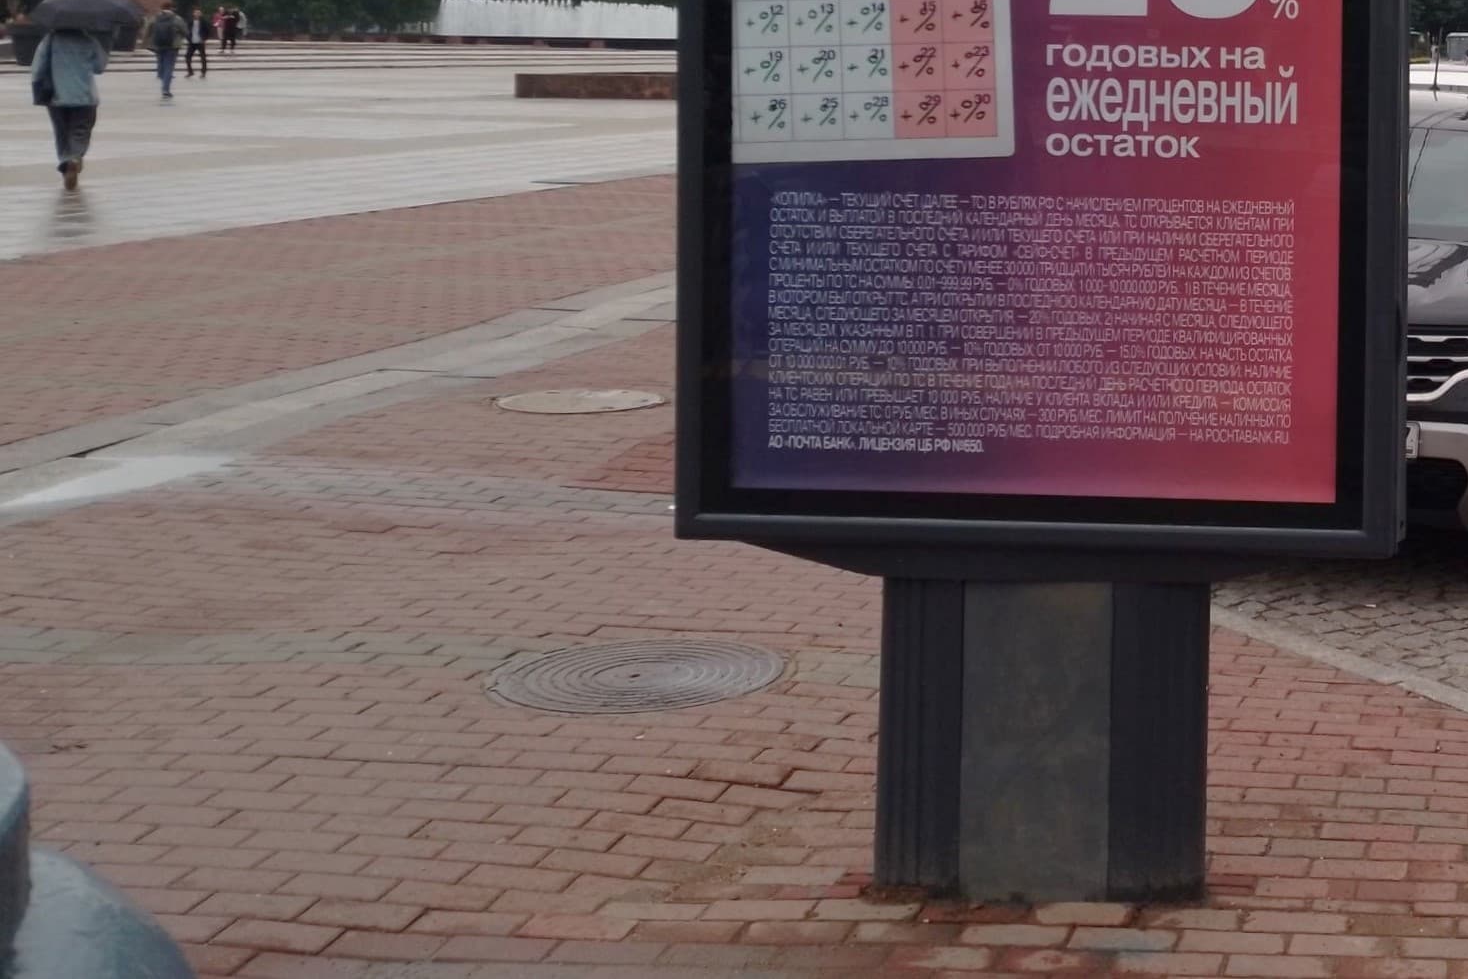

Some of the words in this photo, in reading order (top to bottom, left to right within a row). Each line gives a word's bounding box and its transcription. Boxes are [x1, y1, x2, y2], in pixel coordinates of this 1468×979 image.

[770, 5, 783, 15] 12
[820, 3, 834, 14] 13
[872, 3, 885, 13] 14
[922, 1, 936, 12] 15
[769, 51, 782, 62] 19
[820, 50, 835, 61] 20
[921, 48, 936, 58] 22
[974, 47, 989, 57] 23
[1046, 44, 1211, 71] годовых
[1220, 46, 1265, 69] на
[975, 94, 990, 104] 30
[1046, 65, 1298, 131] ежедневный
[1046, 133, 1200, 158] остаток
[1142, 198, 1203, 213] ПРОЦЕНТОВ
[1222, 199, 1294, 215] ЕЖЕДНЕВНЫЙ
[1044, 213, 1072, 227] ДЕНЬ
[1140, 215, 1213, 230] ОТКРЫВАЕТСЯ
[1216, 217, 1270, 231] КЛИЕНТАМ
[1273, 218, 1294, 232] ПРИ
[1199, 233, 1294, 248] СБЕРЕГАТЕЛЬНОГО
[1245, 250, 1294, 264] ПЕРИОДЕ
[1248, 348, 1292, 362] ОСТАТКА
